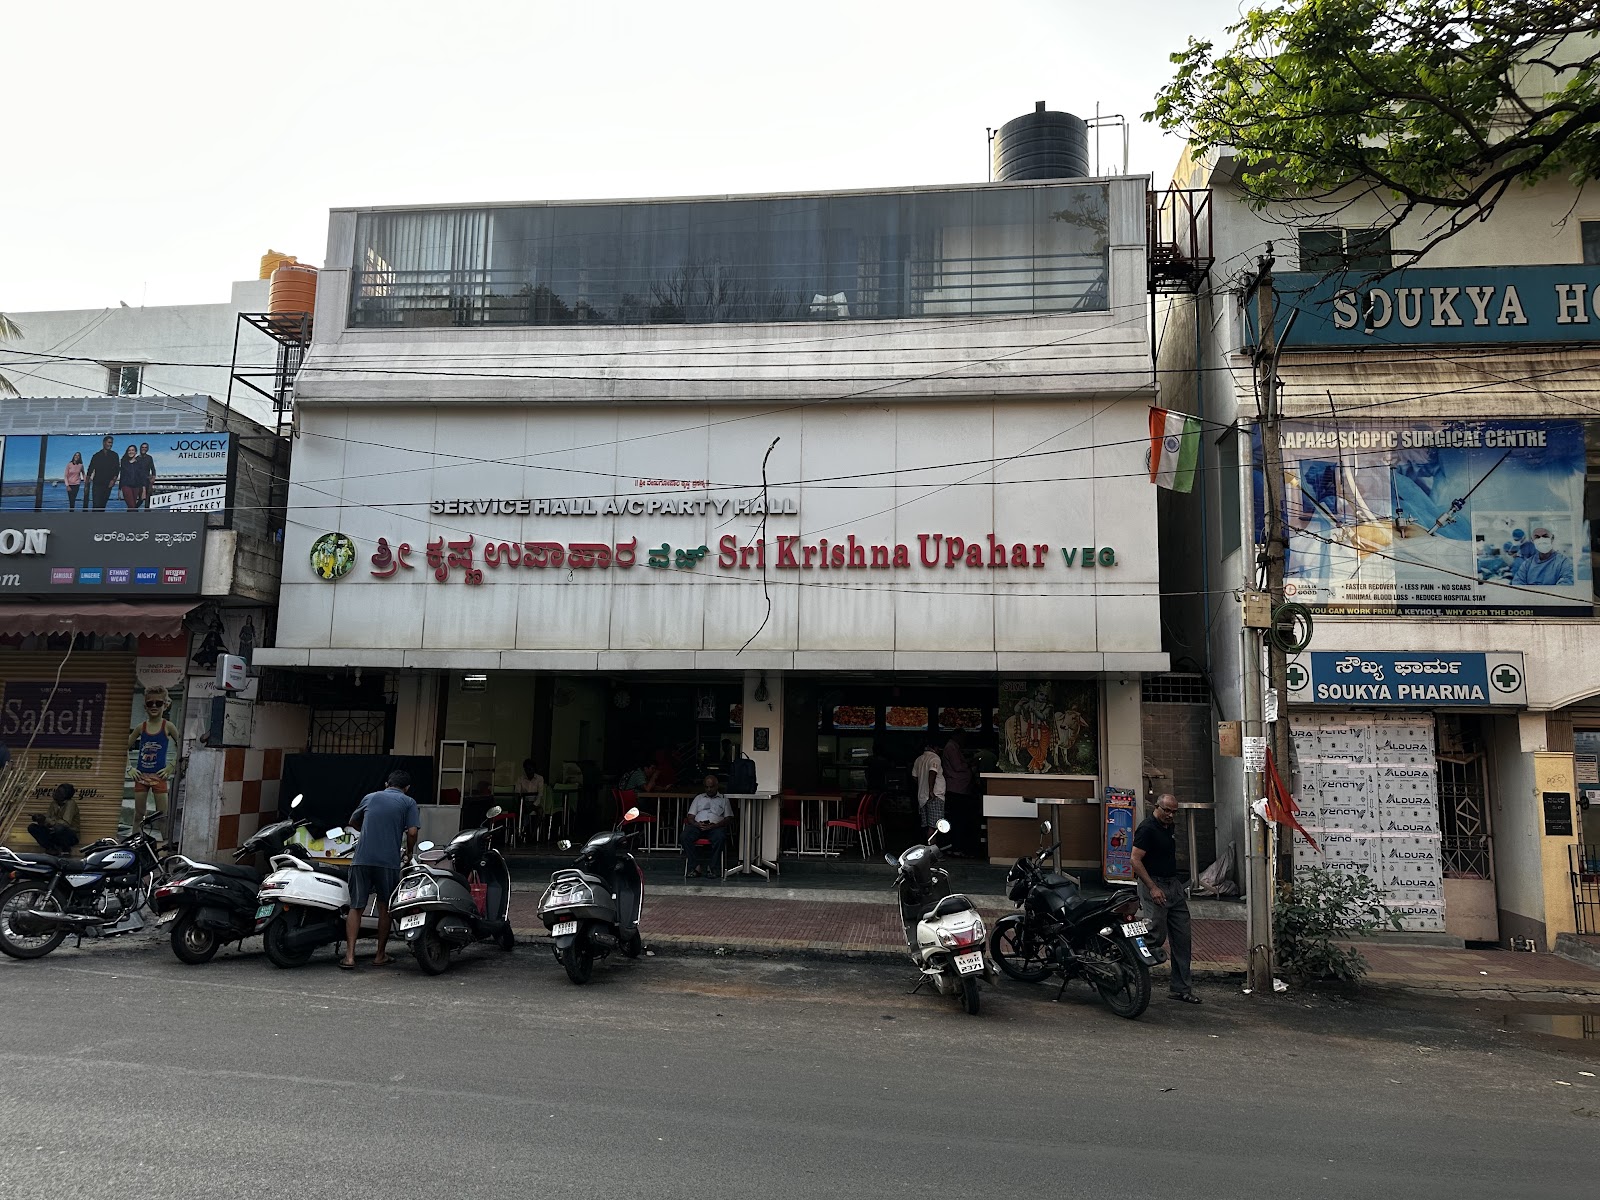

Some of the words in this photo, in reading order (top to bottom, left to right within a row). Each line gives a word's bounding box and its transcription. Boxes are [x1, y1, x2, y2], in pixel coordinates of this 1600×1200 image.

[1333, 284, 1529, 330] SOUKYA
[1555, 283, 1600, 325] H
[170, 440, 226, 451] JOCKEY
[1279, 430, 1398, 449] LAPAROSCOPIC
[1401, 430, 1482, 449] SURGICAL
[1485, 430, 1547, 449] CENTRE
[152, 495, 172, 505] LIVE
[178, 492, 194, 501] THE
[200, 488, 221, 498] CITY
[430, 499, 535, 515] SERVICE
[538, 499, 598, 516] HALL
[602, 500, 644, 516] A/C
[648, 500, 730, 516] PARTY
[734, 499, 798, 515] HALL
[719, 534, 765, 569] Sri
[775, 534, 911, 569] Krishna
[370, 537, 414, 579] ಶ್ರೀ
[427, 535, 484, 585] ಕೃಷ್ಣ
[484, 536, 638, 569] ಉಪಾಹಾರ
[648, 542, 711, 569] ವೆಜ್
[1336, 656, 1385, 681] ಸೌಖ್ಯ
[1317, 684, 1392, 700] SOUKYA
[1398, 684, 1485, 700] PHARMA
[3, 699, 93, 736] Saheli
[1384, 740, 1428, 750] ALDURA
[1384, 768, 1429, 777] ALDURA
[1386, 794, 1430, 804] ALDURA
[1387, 820, 1432, 831] ALDURA
[1389, 848, 1434, 859] ALDURA
[1391, 876, 1436, 886] ALDURA
